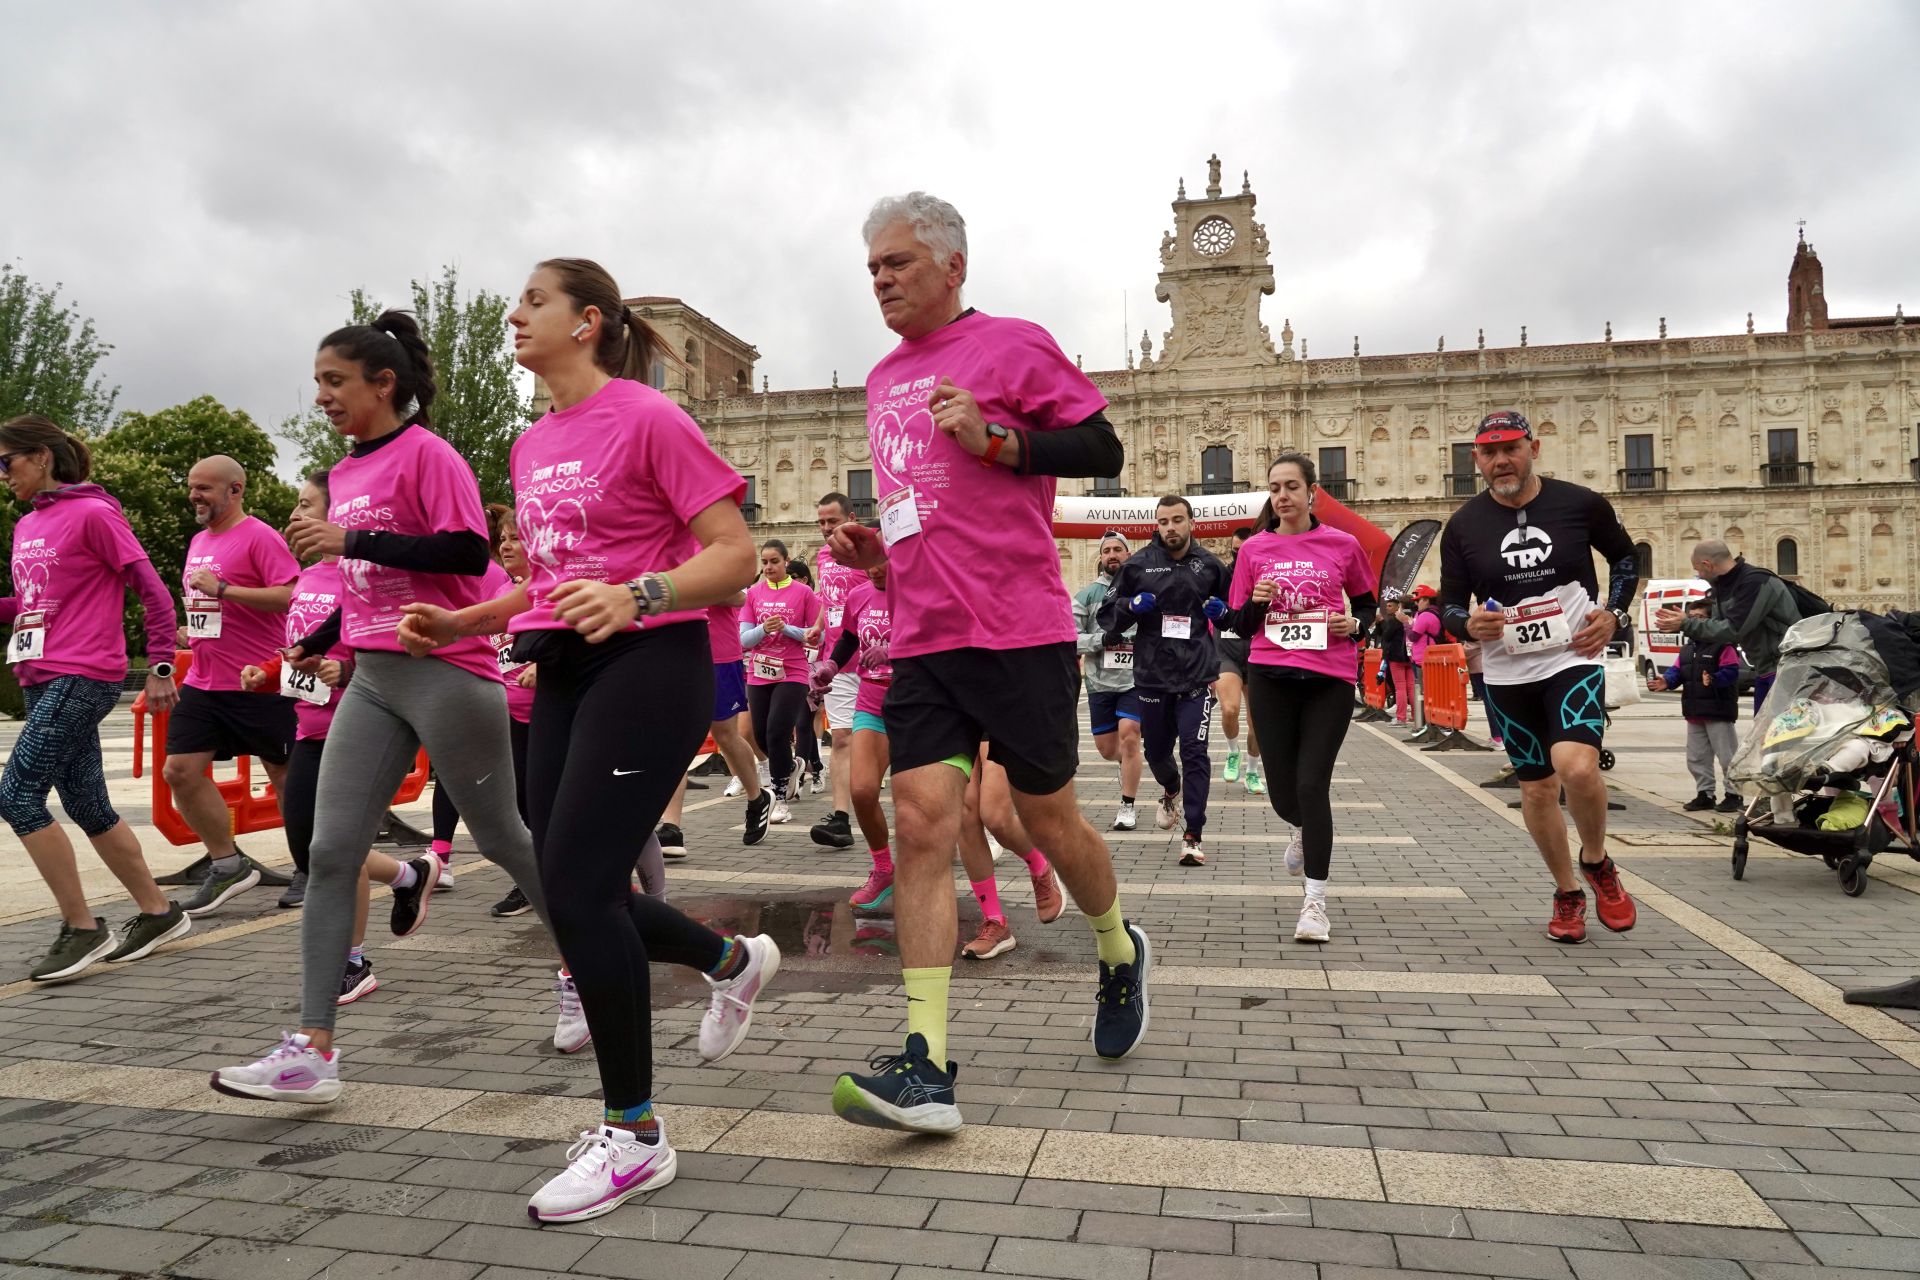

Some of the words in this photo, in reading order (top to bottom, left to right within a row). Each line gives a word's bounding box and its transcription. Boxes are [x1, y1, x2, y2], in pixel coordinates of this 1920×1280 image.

[889, 382, 911, 398] RUN
[912, 375, 936, 391] FOR
[873, 390, 933, 413] PARKINSO
[531, 465, 554, 483] RUN
[556, 461, 582, 477] FOR
[352, 495, 370, 511] FOR
[1193, 507, 1209, 518] DE
[1213, 502, 1247, 517] LEÓN
[1194, 522, 1228, 531] PORTES
[1274, 561, 1293, 570] RUN
[1295, 560, 1314, 569] FOR
[1503, 567, 1556, 582] TRANSVULCANIA
[316, 594, 336, 604] FOR
[869, 609, 883, 617] RUN
[190, 613, 208, 630] 417
[1280, 625, 1312, 642] 233
[1516, 620, 1551, 644] 321
[1114, 652, 1133, 664] 327
[761, 665, 777, 677] 373
[287, 667, 317, 693] 423
